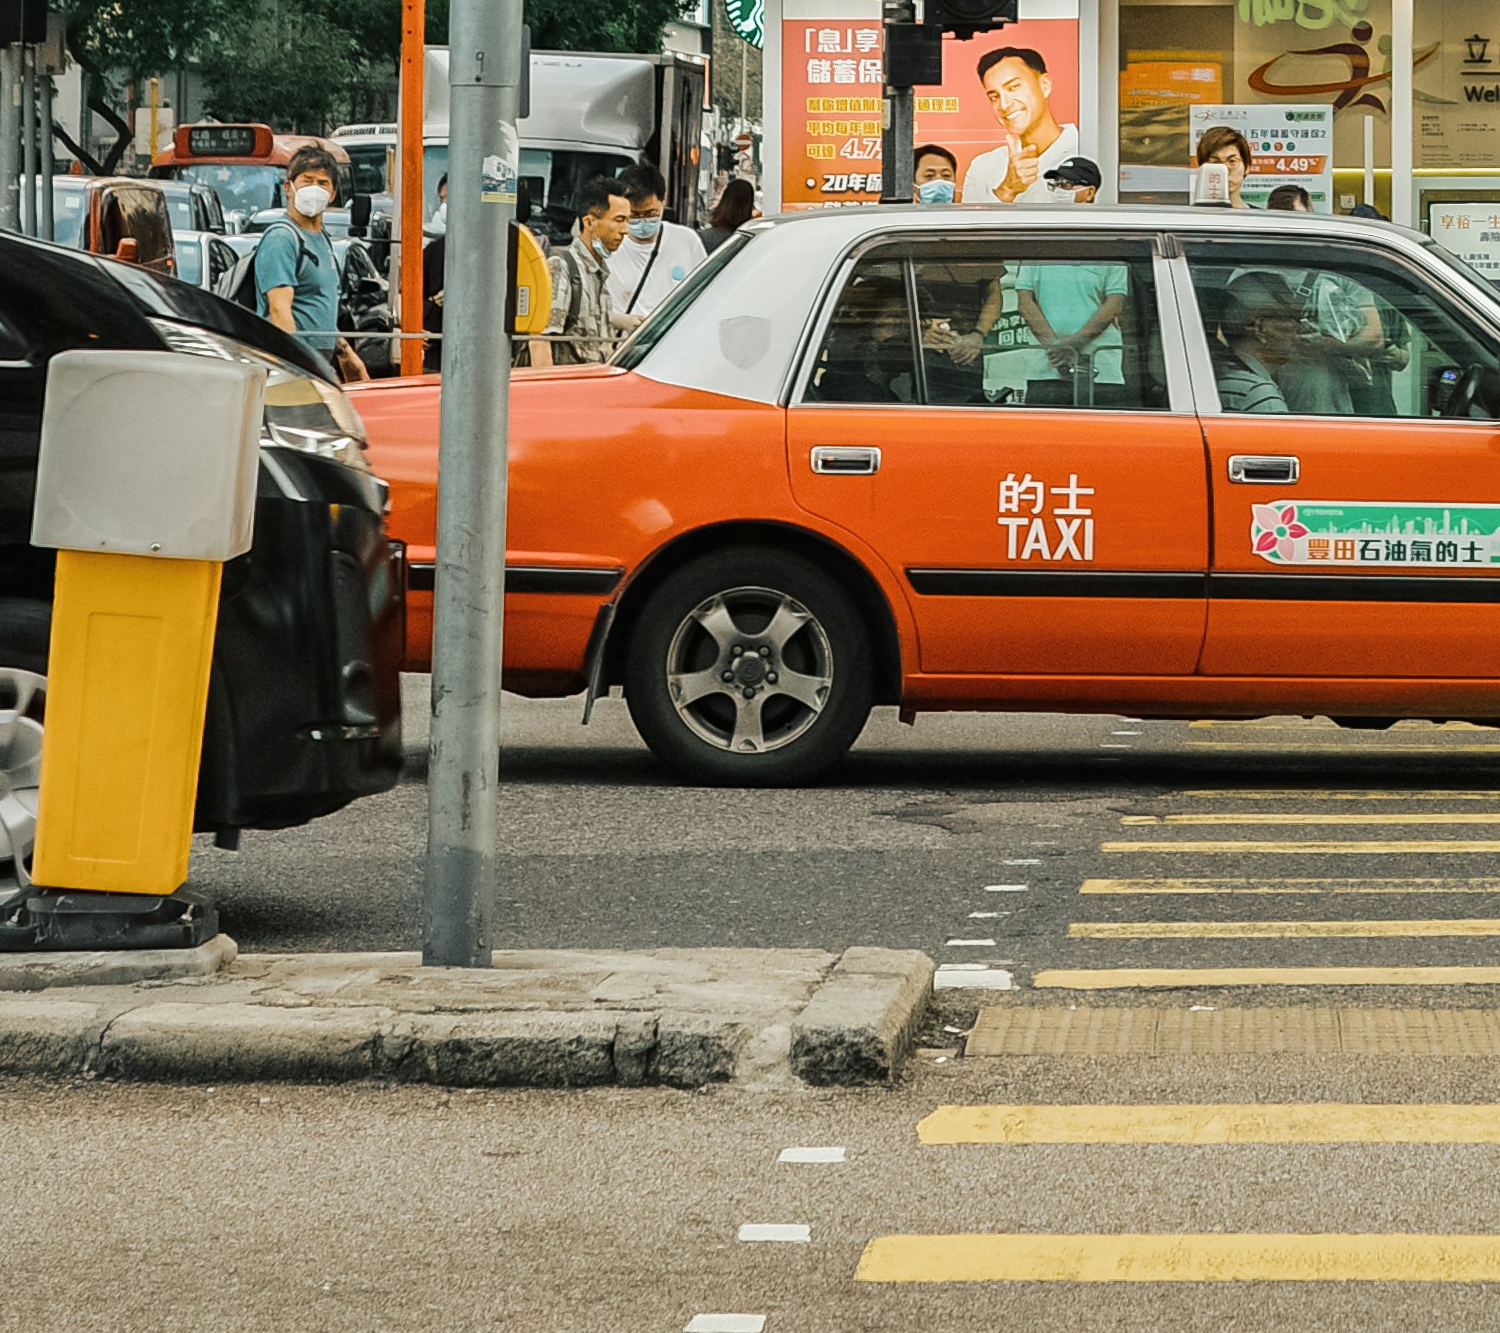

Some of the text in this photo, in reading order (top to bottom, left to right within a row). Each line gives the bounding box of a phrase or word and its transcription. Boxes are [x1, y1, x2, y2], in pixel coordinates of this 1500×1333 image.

[804, 27, 886, 55] 「息」享
[1208, 172, 1220, 199] 的士
[998, 472, 1095, 515] 的士
[999, 517, 1094, 562] TAXI
[1307, 538, 1485, 563] 豐田石油氣的士
